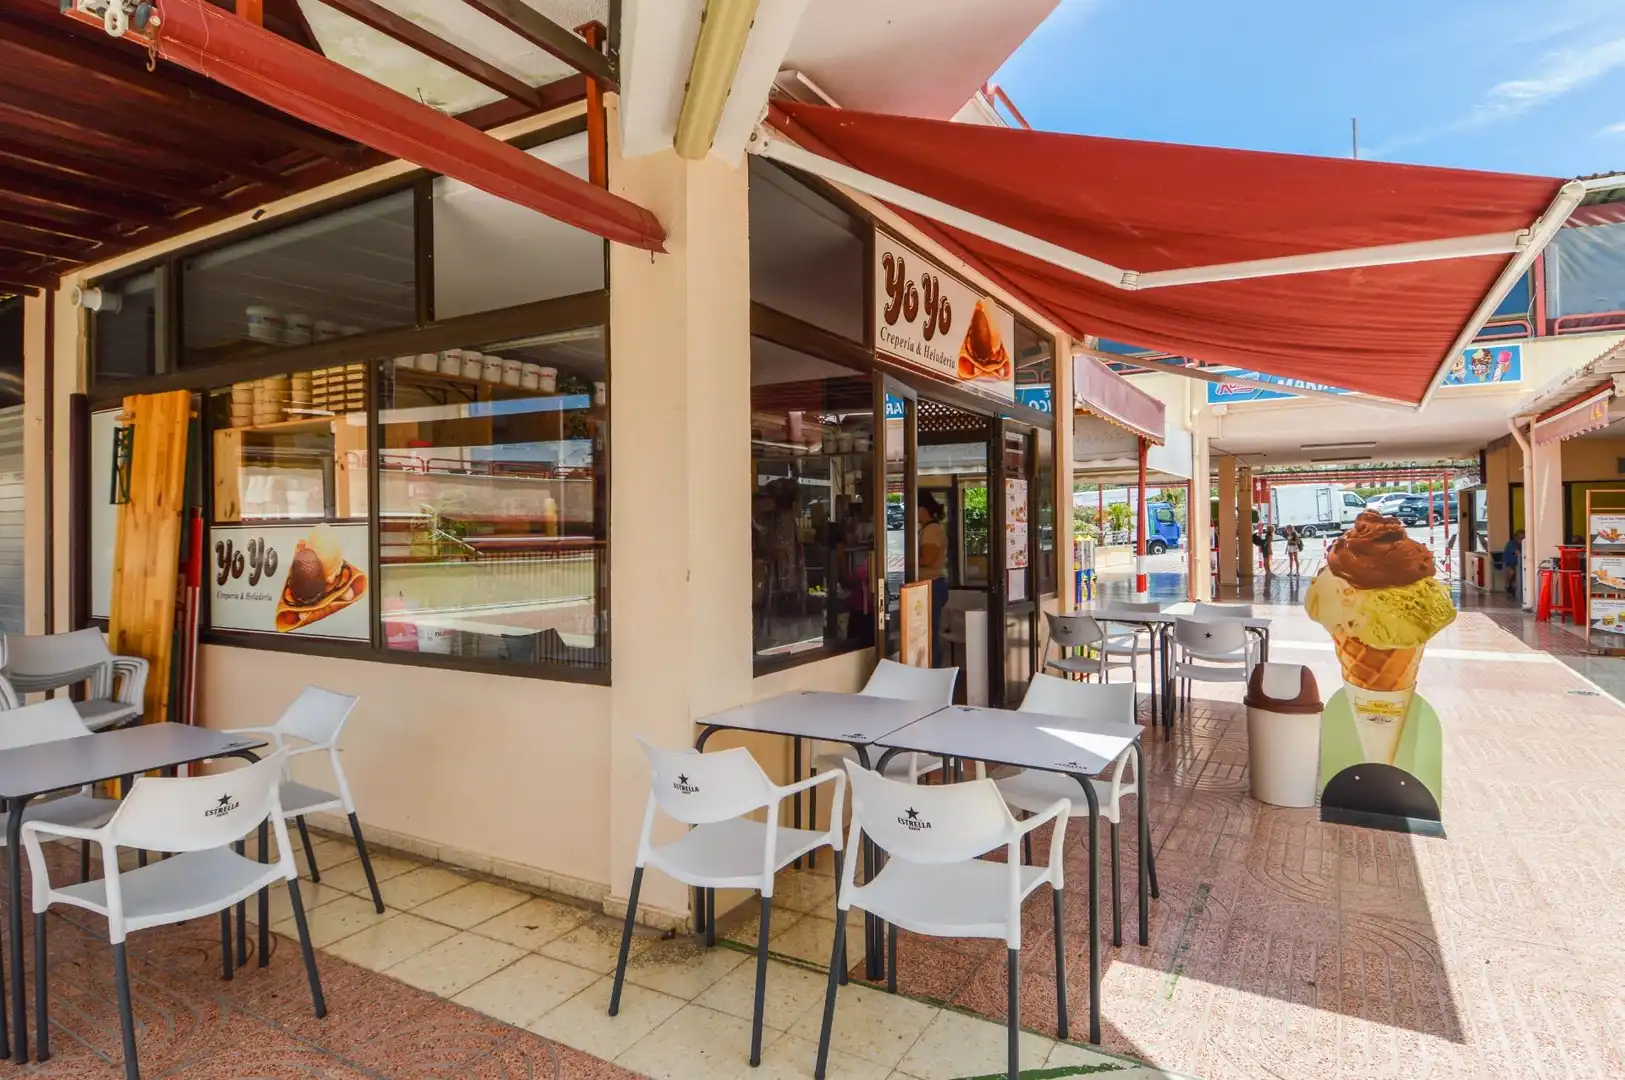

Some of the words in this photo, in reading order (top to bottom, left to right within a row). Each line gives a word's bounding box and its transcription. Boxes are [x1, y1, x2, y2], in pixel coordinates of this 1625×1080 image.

[916, 341, 922, 355] &
[673, 782, 700, 793] ESTRELLA
[204, 801, 240, 817] ESTRELLA
[897, 817, 932, 829] ESTRELLA
